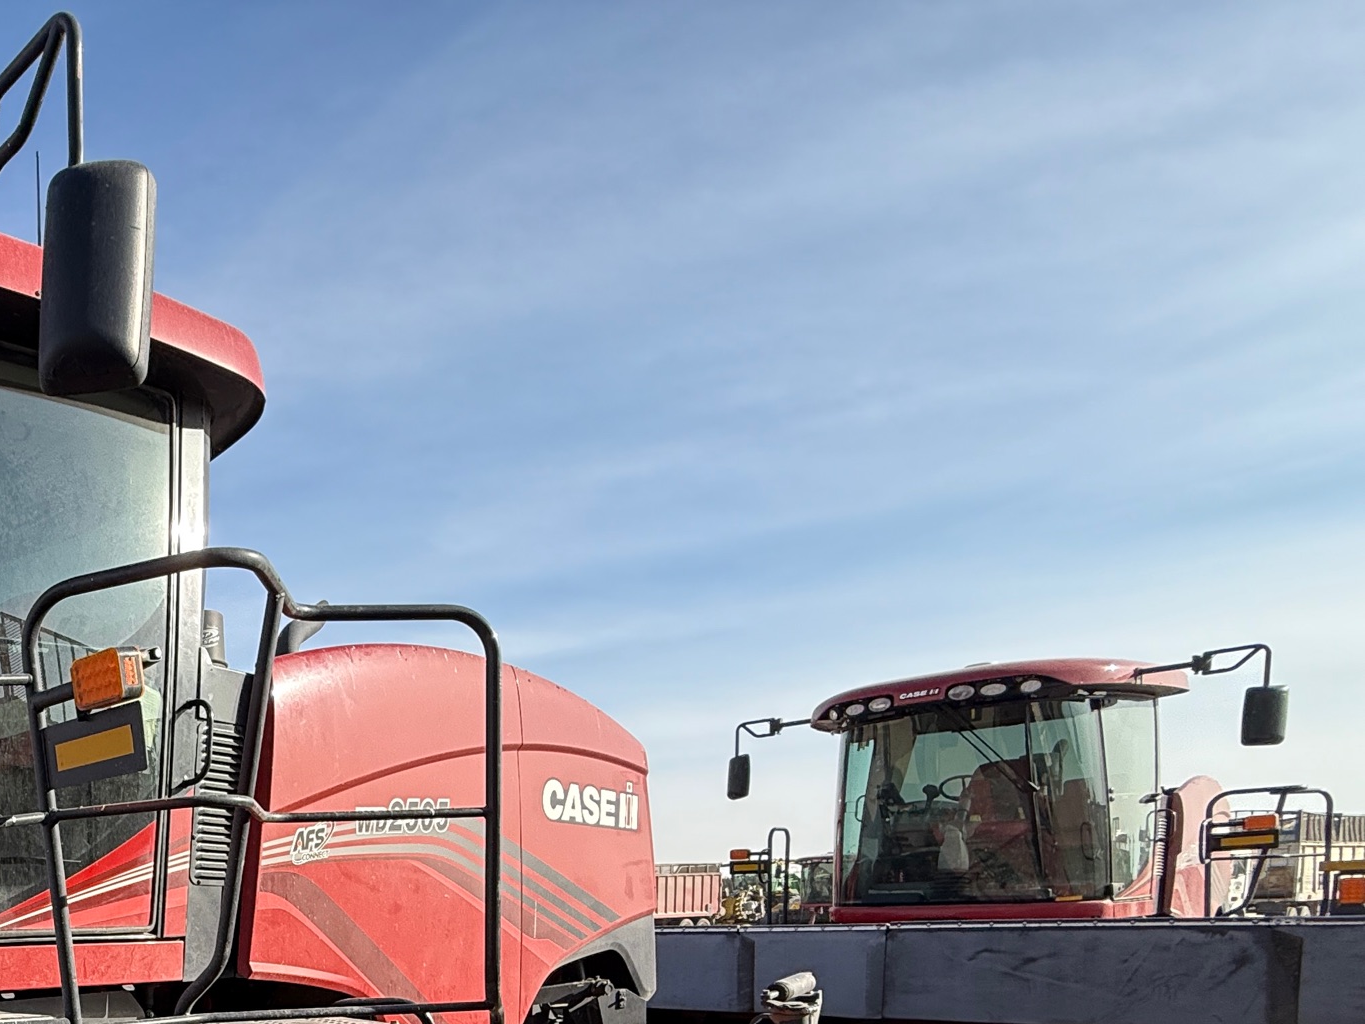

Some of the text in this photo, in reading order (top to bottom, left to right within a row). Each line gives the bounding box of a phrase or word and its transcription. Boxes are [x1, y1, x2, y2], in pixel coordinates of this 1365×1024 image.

[899, 690, 927, 699] CASE
[542, 778, 616, 827] CASE
[293, 826, 328, 852] AFS
[301, 850, 329, 861] CONNECT
